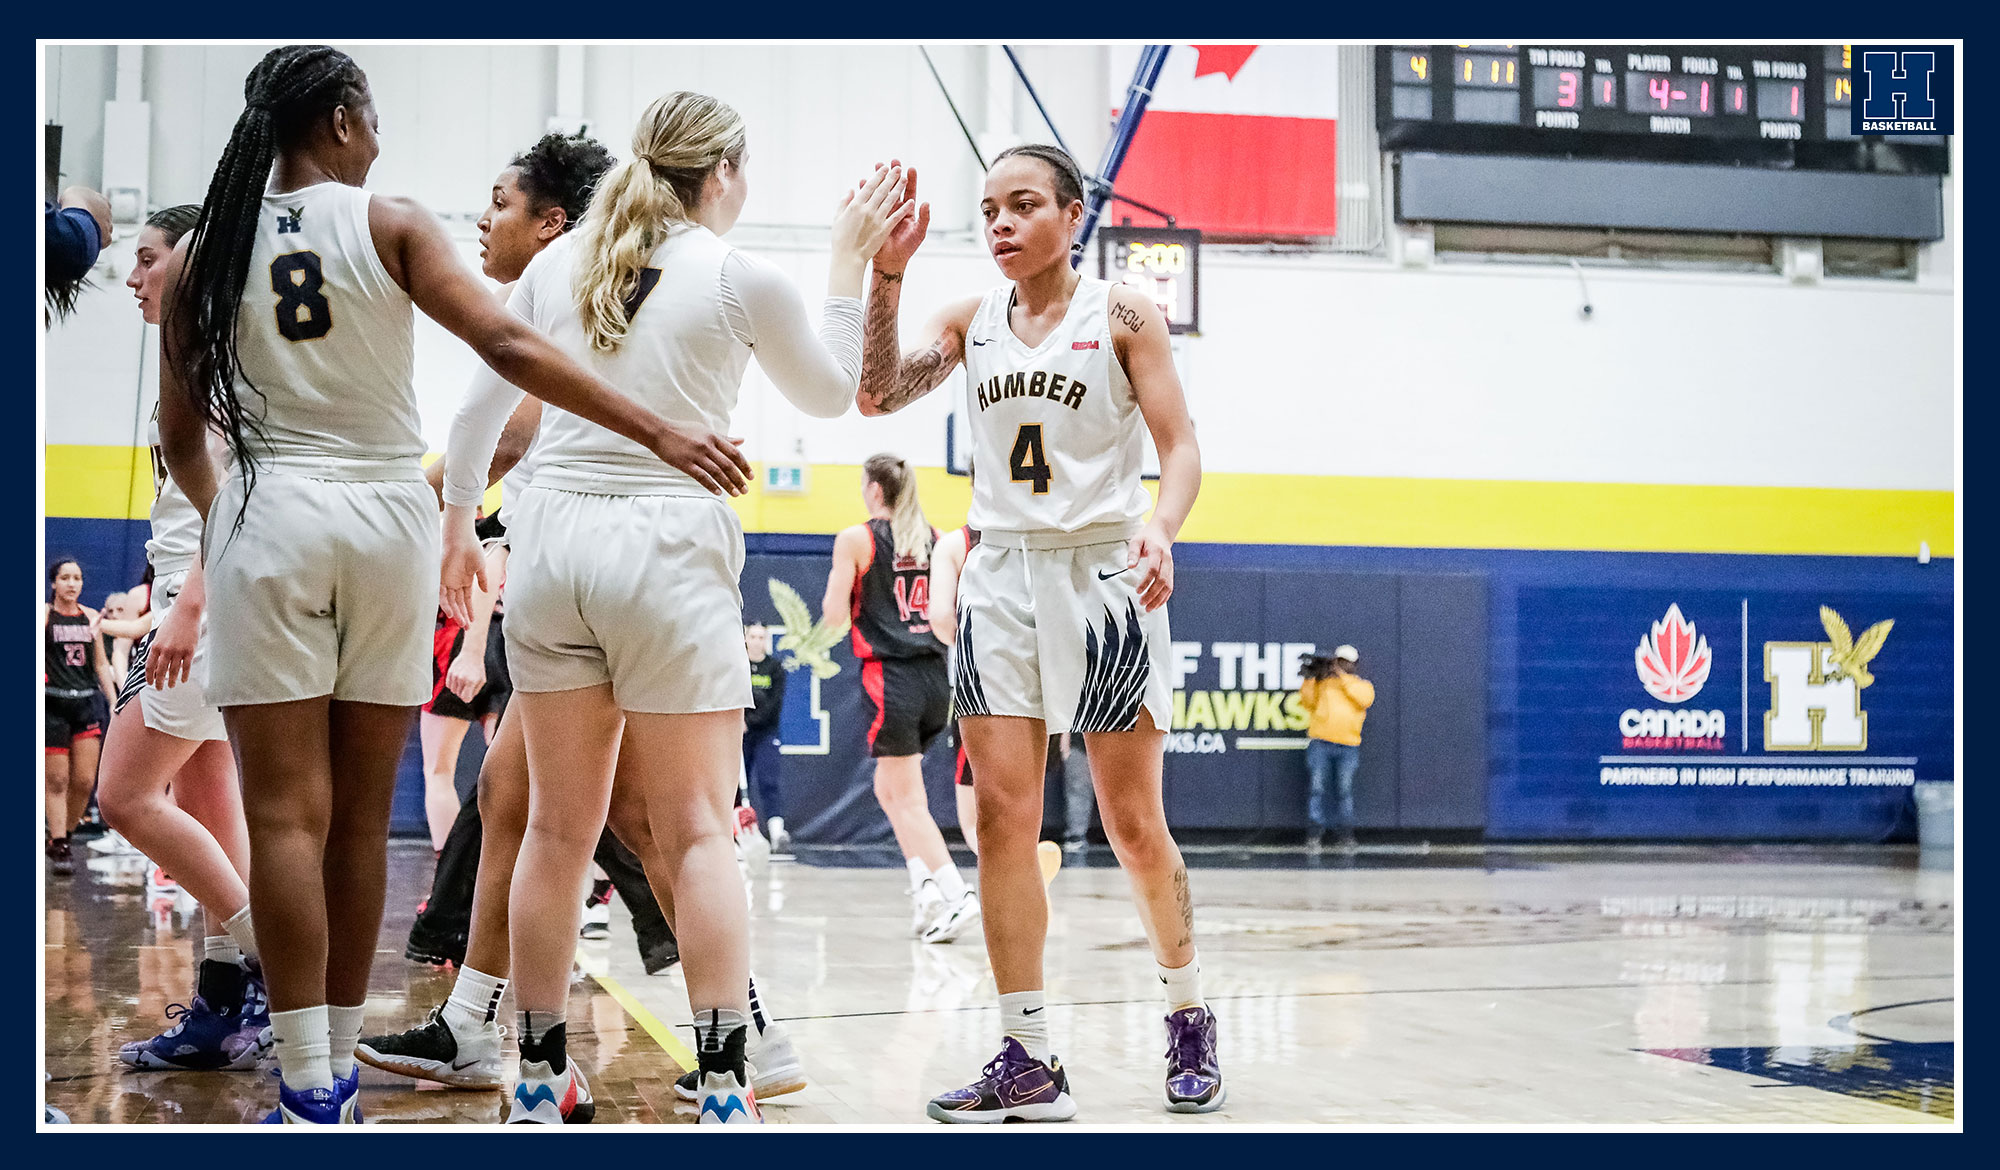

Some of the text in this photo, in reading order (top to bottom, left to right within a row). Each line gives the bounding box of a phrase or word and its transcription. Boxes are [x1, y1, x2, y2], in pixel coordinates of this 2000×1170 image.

[1549, 50, 1586, 68] FOULS
[1627, 53, 1718, 75] PLAYER FOULS
[1771, 62, 1807, 80] FOULS
[1557, 72, 1577, 107] 3
[1536, 110, 1579, 129] POINTS
[1650, 116, 1691, 134] MATCH
[1760, 121, 1802, 139] POINTS
[1127, 242, 1186, 274] 2:00
[269, 249, 334, 344] 8
[977, 371, 1088, 412] HUMBER
[1009, 422, 1054, 495] 4
[893, 576, 930, 622] 14
[1212, 642, 1316, 690] THE
[1764, 641, 1868, 751] H
[1619, 708, 1726, 738] CANADA
[1600, 767, 1915, 787] PARTNERS IN HIGH PERFORMANCE TRAINING
